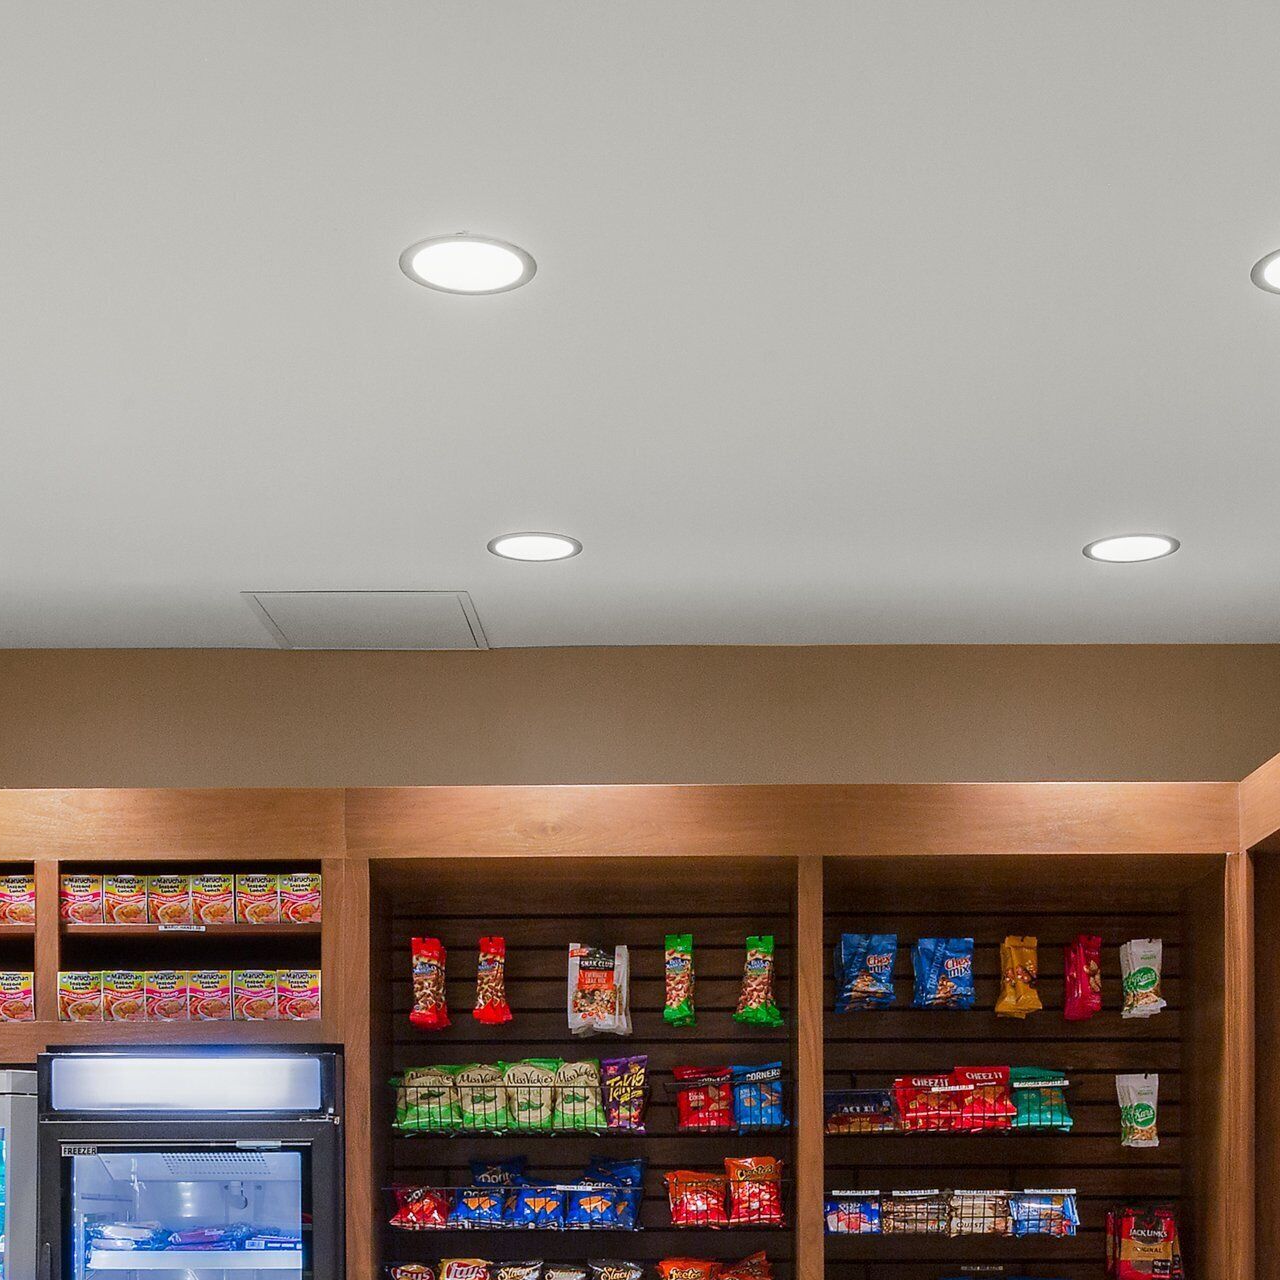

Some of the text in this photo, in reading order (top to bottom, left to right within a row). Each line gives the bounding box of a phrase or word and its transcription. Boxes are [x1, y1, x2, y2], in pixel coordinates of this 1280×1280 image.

[867, 954, 892, 967] Chex
[945, 956, 971, 970] Chex
[948, 966, 969, 977] mix
[507, 1071, 526, 1084] Miss
[556, 1071, 577, 1084] Miss
[63, 1147, 97, 1155] FREEZER
